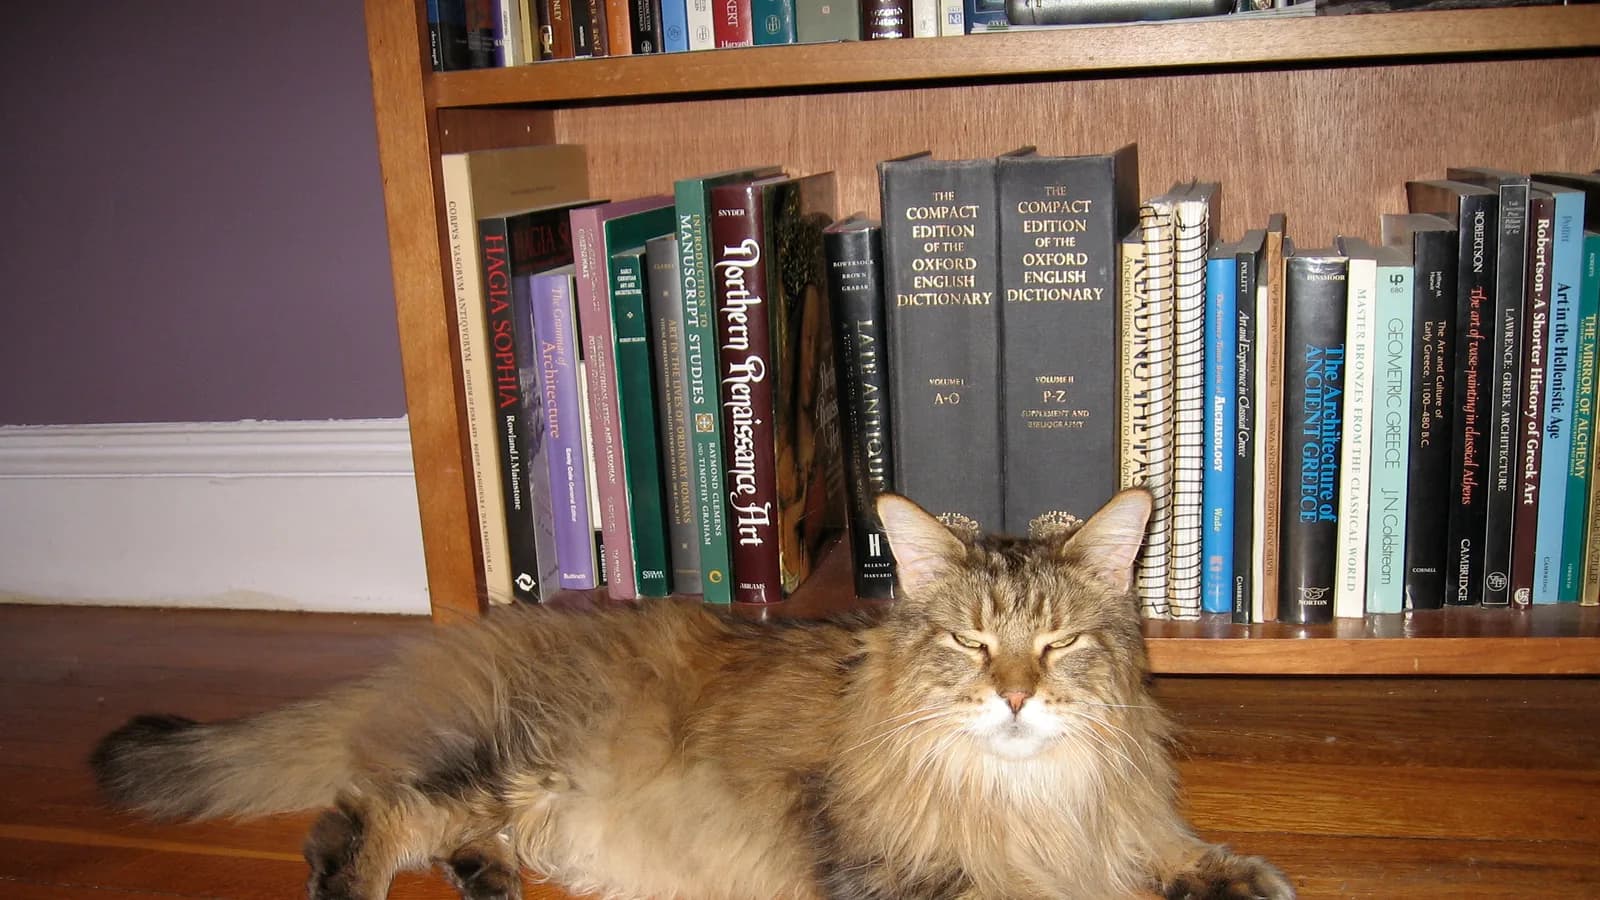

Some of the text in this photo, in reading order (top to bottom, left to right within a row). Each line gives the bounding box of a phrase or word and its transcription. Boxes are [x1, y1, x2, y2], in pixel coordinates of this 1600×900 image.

[933, 191, 954, 201] THE
[1018, 200, 1092, 213] COMPACT
[1044, 185, 1066, 197] THE
[717, 208, 745, 217] SNYDER
[906, 205, 979, 220] COMPACT
[912, 224, 975, 238] EDITION
[1023, 219, 1087, 233] EDITION
[924, 242, 964, 252] OF THE
[1023, 253, 1088, 267] OXFORD
[1035, 237, 1076, 247] OF THE
[1472, 211, 1484, 273] ROBERTSON
[449, 200, 471, 361] CORPVS VASORVM ANTIQVORVM
[690, 213, 708, 327] INTRODUCTION TO
[912, 257, 977, 271] OXFORD
[913, 275, 975, 288] ENGLISH
[1024, 270, 1086, 284] ENGLISH
[1434, 271, 1443, 289] Jeffrey
[678, 214, 705, 405] MANUSCRIPT STUDIES
[897, 292, 992, 307] DICTIONARY
[1007, 287, 1104, 302] DICTIONARY
[484, 232, 521, 408] HAGIA SOPHIA
[552, 287, 569, 369] The Grammar of
[1238, 326, 1248, 342] and
[1239, 310, 1250, 326] Art
[1121, 256, 1132, 455] Ancient Writing from Cuneiform to the
[1236, 343, 1249, 384] Experience
[1434, 320, 1446, 418] The Art and Culture of
[1523, 218, 1549, 504] Robertson A Shorter History of Greek Art
[1546, 283, 1570, 439] Art in the Hellenistic Age
[540, 339, 567, 439] Architecture
[714, 238, 771, 546] Northern Renaissance Art
[934, 392, 960, 405] A-O
[1035, 376, 1066, 384] VOLUME
[1043, 390, 1066, 403] P-Z
[1238, 386, 1248, 394] in
[1383, 317, 1403, 468] GEOMETRIC GREECE
[1420, 321, 1433, 448] Early Greece, B.C.
[1461, 286, 1487, 505] The art of vase-painting in classical Athens
[1497, 308, 1514, 492] LAWRENCE: GREEK ARCHITECTURE
[1574, 313, 1596, 479] THE MIRROR OF ALCHEMY
[667, 319, 691, 523] ART IN THE LIVES OF ORDINARY ROMANS
[857, 319, 885, 492] LATE ANTIQUI
[1022, 409, 1089, 418] SUPPLEMENT AND
[1028, 420, 1084, 428] BIBLIOGRAPHY
[1238, 395, 1249, 428] Classical
[1212, 395, 1225, 471] ARCHAEOLOGY
[1238, 430, 1249, 458] Greece
[1299, 343, 1323, 523] ANCIENT GREECE
[1319, 343, 1343, 522] The Architecture of
[1346, 288, 1366, 592] MASTER BRONZES FROM THE CLASSICAL WORLD
[506, 415, 521, 510] Rowland J. Mainstone
[698, 457, 709, 502] TIMOTHY
[564, 447, 577, 522] Emily Cole General Editor
[708, 442, 722, 536] RAYMOND CLEMENS
[702, 505, 711, 544] GRAHAM
[1212, 507, 1222, 532] Wade
[1380, 513, 1398, 585] Coldstream
[1457, 538, 1470, 601] CAMBRIDGE
[1298, 598, 1328, 606] NORTON
